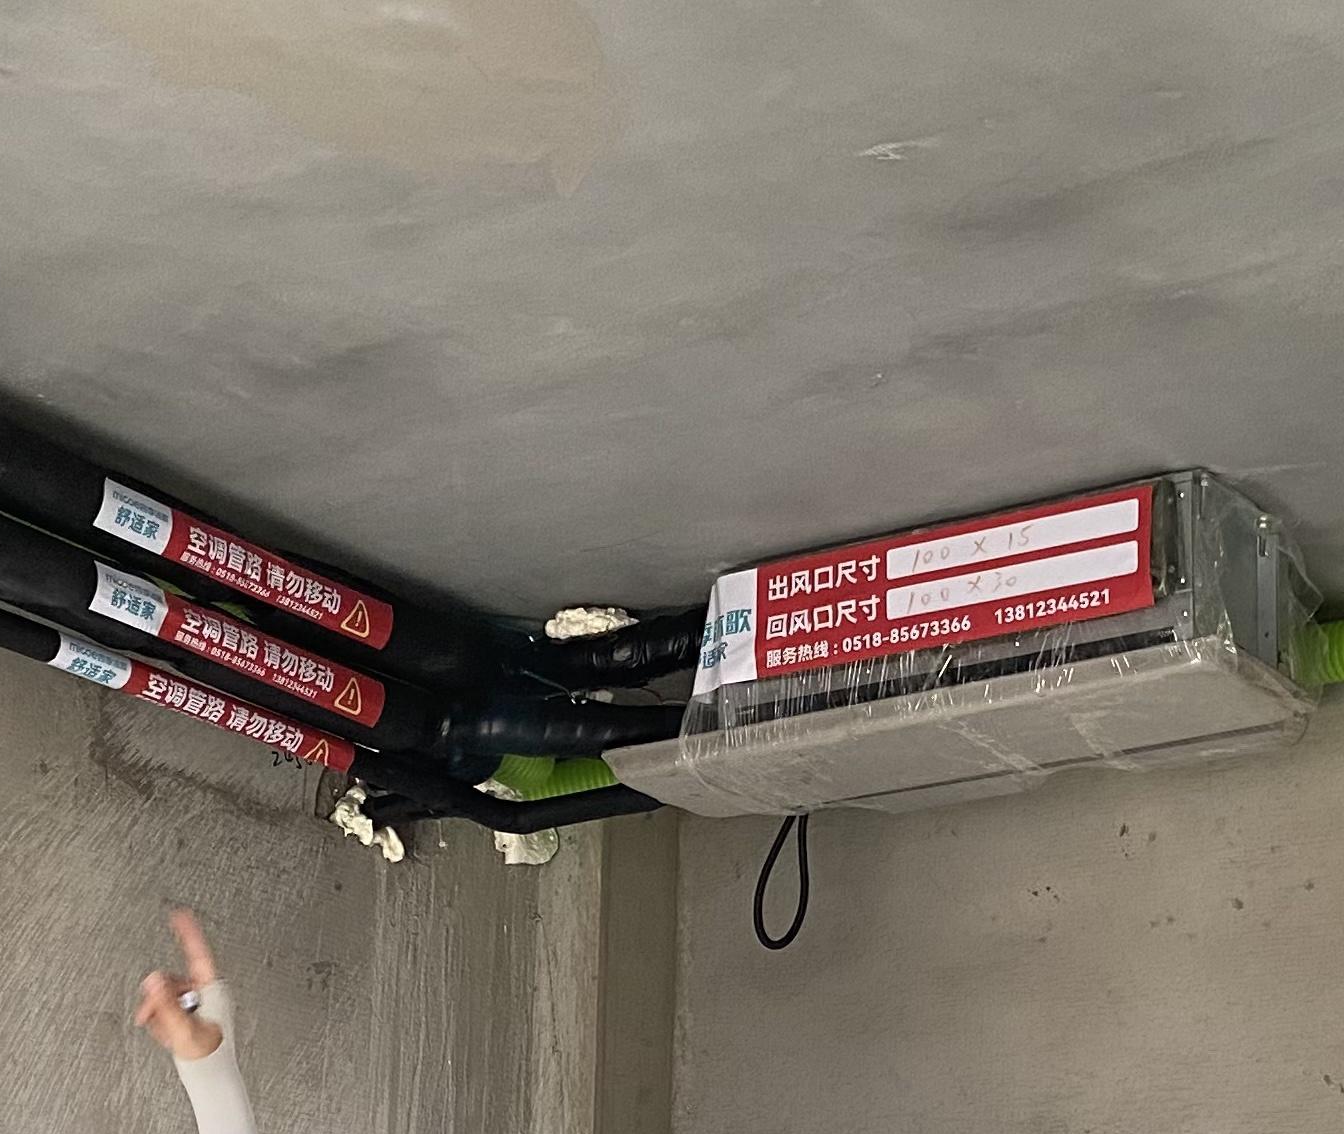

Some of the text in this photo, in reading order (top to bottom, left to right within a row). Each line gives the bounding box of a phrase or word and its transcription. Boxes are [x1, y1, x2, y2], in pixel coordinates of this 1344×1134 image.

[114, 506, 160, 540] 舒适家
[187, 526, 342, 615] 空调管路 请勿移动
[768, 554, 881, 601] 出风口尺寸
[911, 546, 951, 574] 100
[111, 588, 156, 621] 舒适家
[766, 594, 881, 640] 回风口尺寸
[995, 588, 1111, 624] 13812344521
[67, 656, 117, 685] 舒适家
[180, 608, 259, 661] 空调管路
[264, 640, 335, 693] 请勿移动
[142, 674, 225, 723] 空调管路
[225, 704, 305, 752] 请勿移动
